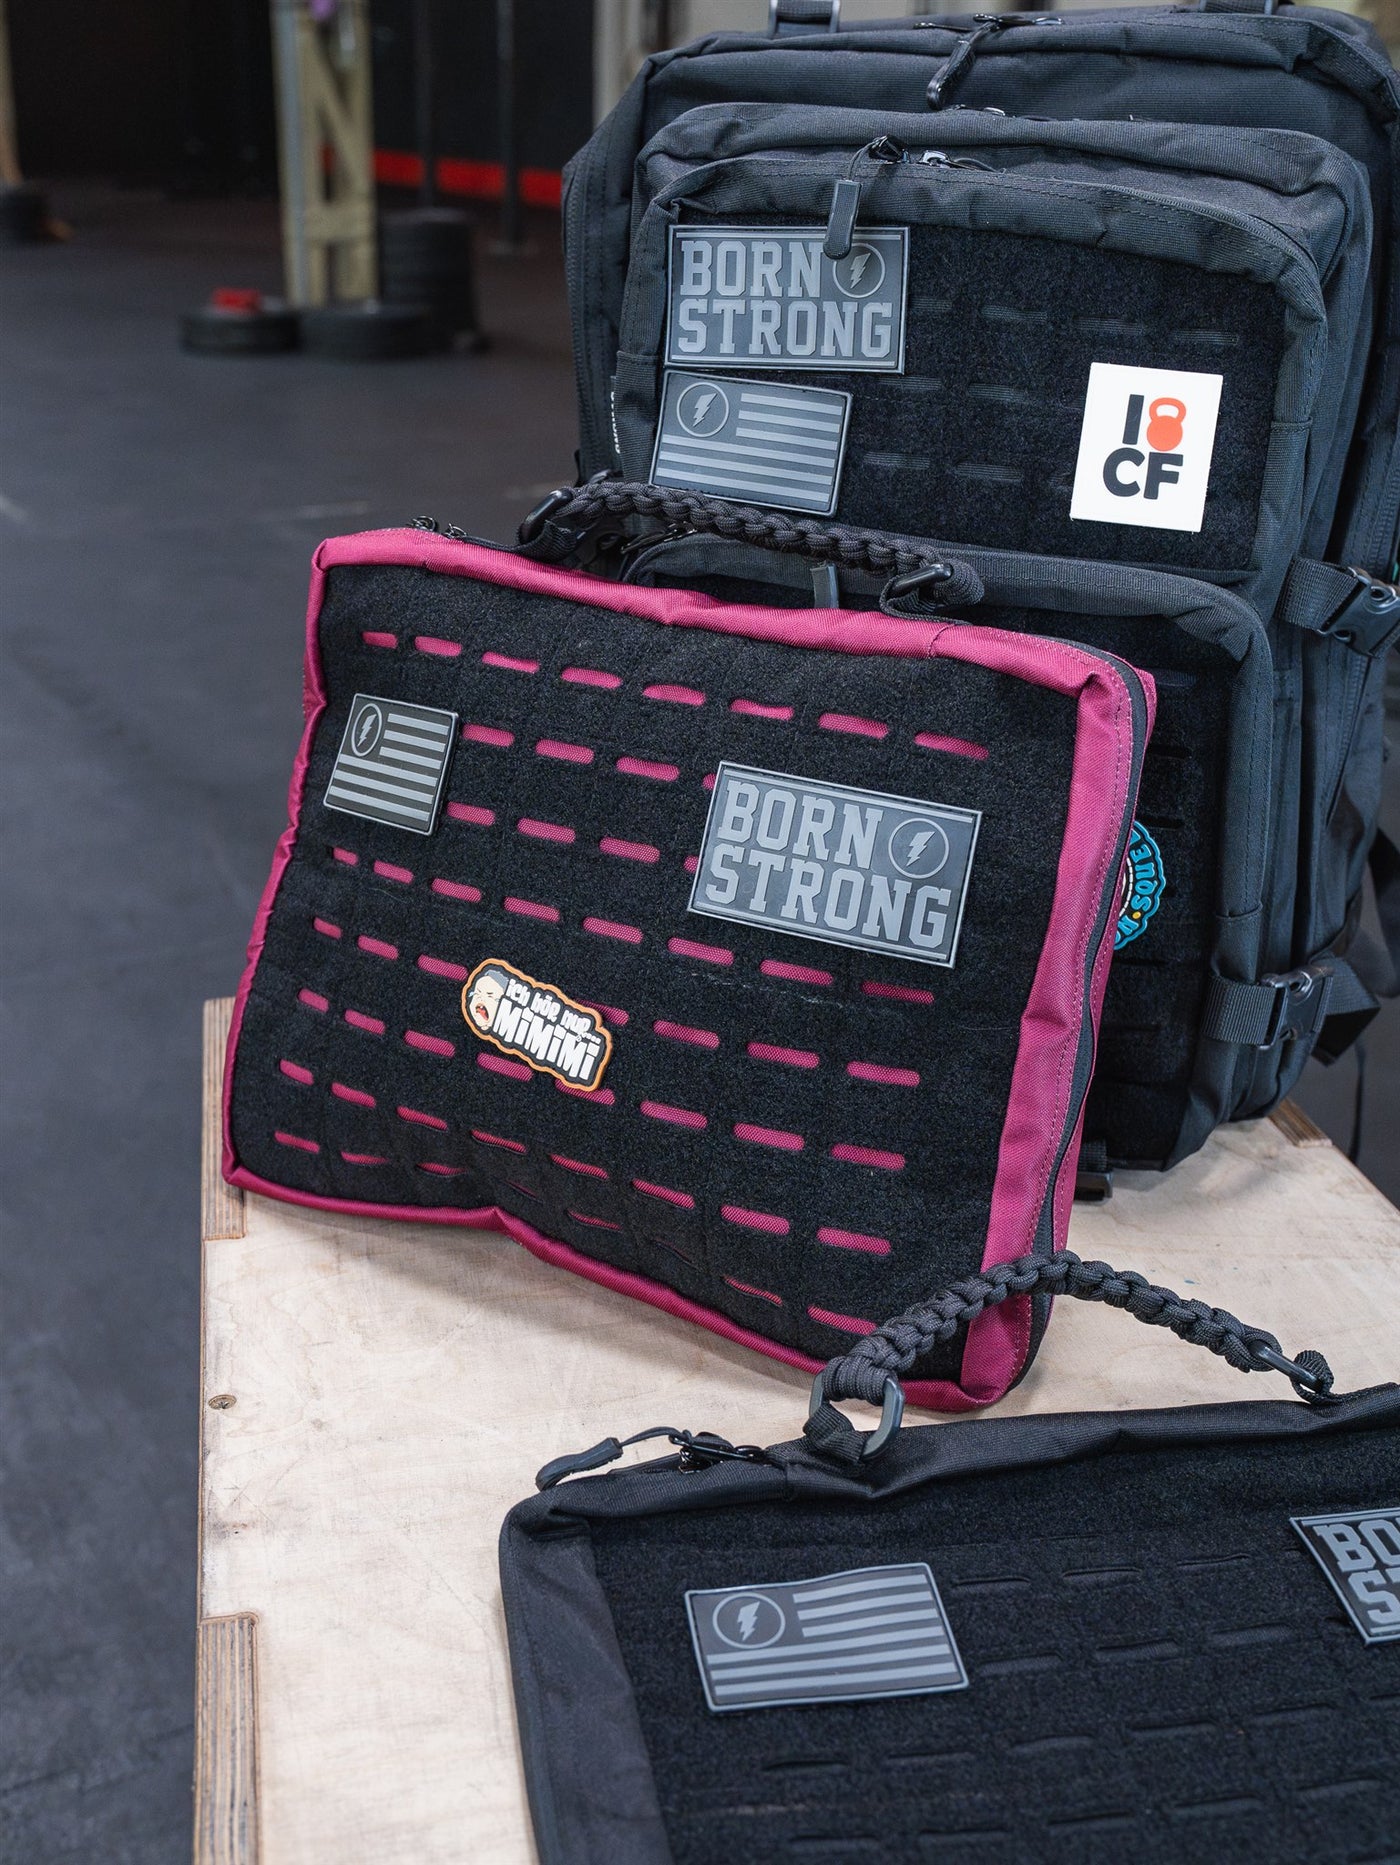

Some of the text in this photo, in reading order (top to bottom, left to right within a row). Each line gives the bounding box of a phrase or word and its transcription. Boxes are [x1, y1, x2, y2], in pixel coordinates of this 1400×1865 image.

[680, 240, 825, 298] BORN
[678, 298, 893, 358] STRONG
[1122, 394, 1145, 445] I
[1102, 447, 1184, 500] CF
[717, 779, 884, 870] BORN
[705, 843, 951, 948] STRONG
[1312, 1517, 1400, 1573] BO
